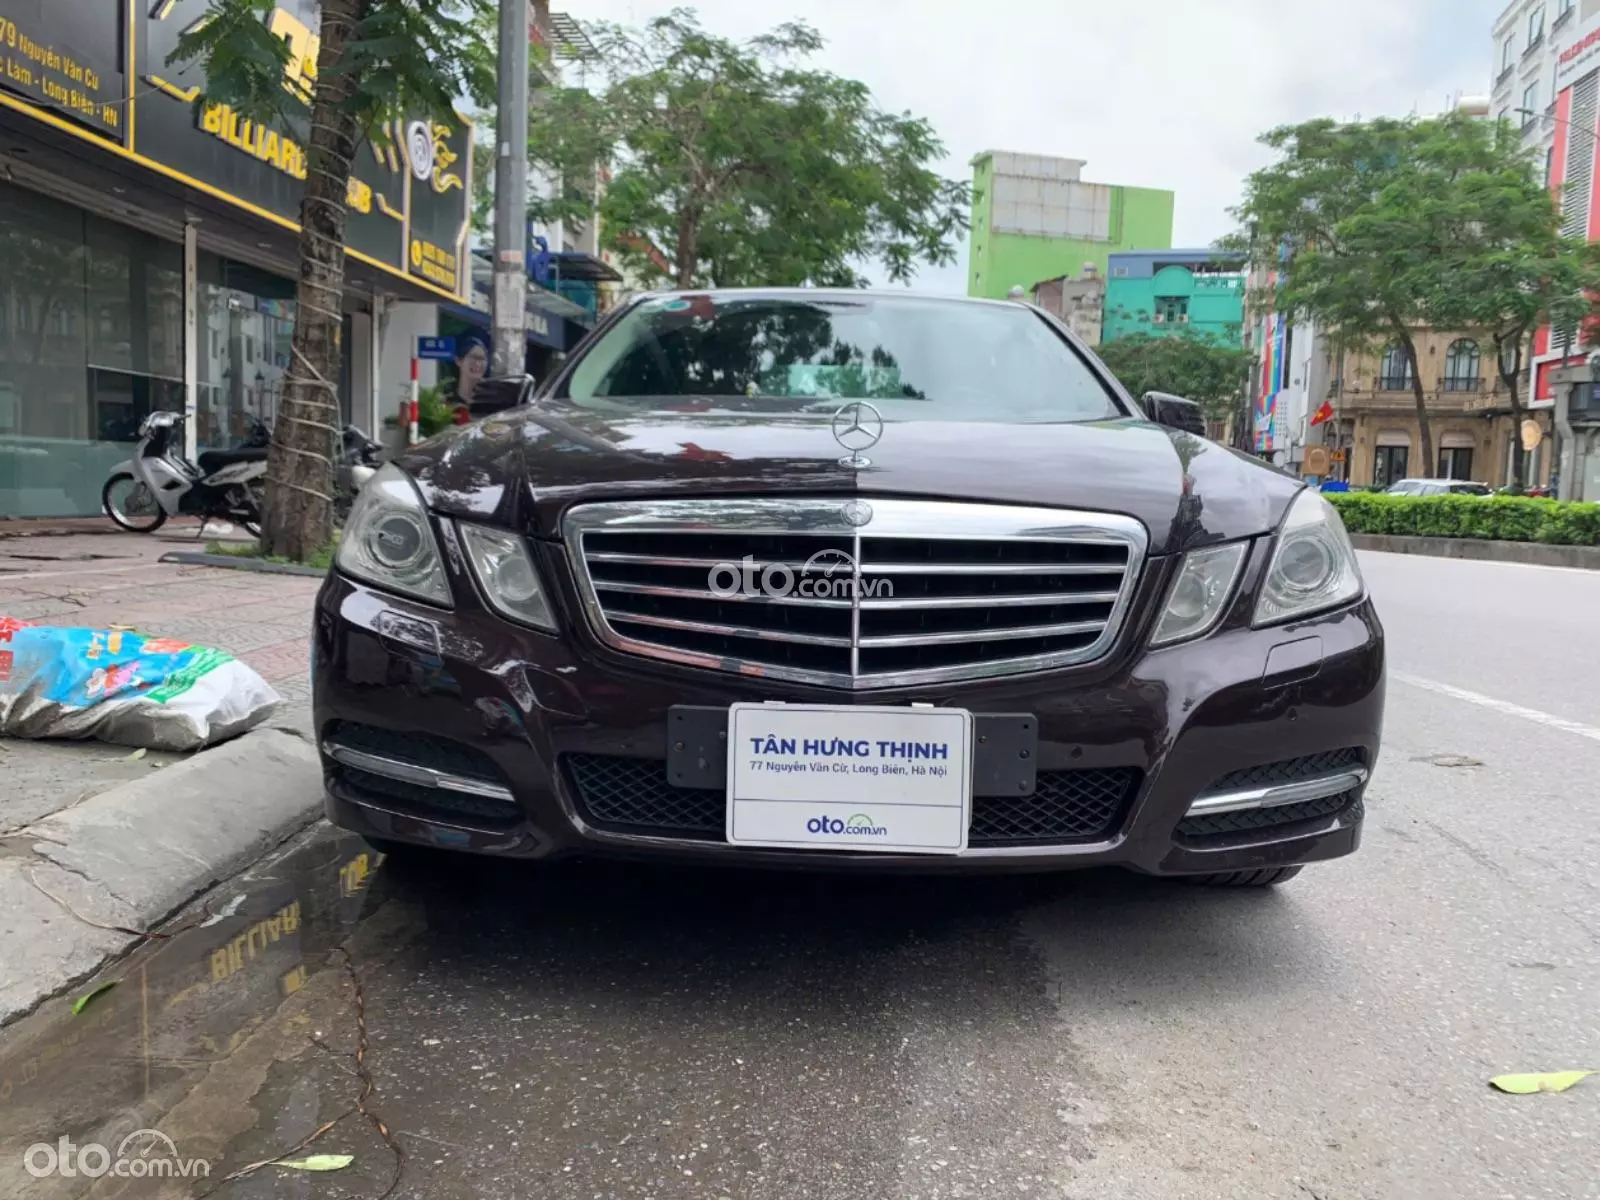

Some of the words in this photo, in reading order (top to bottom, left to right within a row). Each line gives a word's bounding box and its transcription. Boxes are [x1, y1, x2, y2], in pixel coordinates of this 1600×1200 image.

[750, 734, 796, 755] TÂN
[803, 737, 870, 757] HƯNG
[876, 741, 948, 762] THỊNH
[750, 761, 763, 770] 77
[810, 762, 829, 772] Văn
[853, 763, 879, 775] Long
[911, 766, 926, 775] Hà
[929, 766, 948, 778] Nội
[807, 815, 888, 836] oto.com.vn
